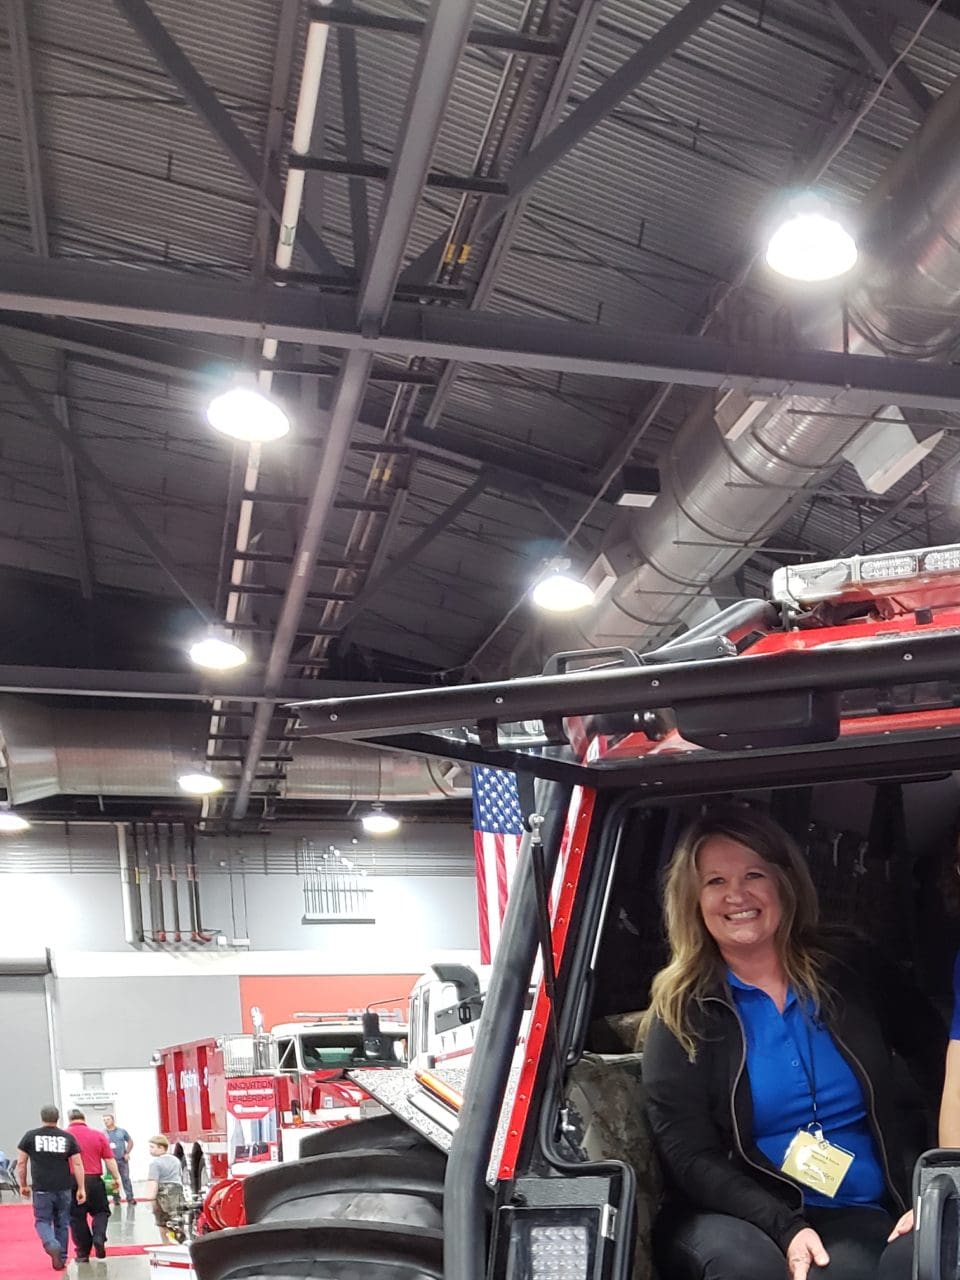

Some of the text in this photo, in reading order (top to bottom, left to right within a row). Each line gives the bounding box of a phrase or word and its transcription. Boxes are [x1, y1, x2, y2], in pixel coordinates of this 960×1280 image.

[228, 1080, 273, 1090] INNOVATION
[228, 1094, 274, 1103] LEADERSHIP
[35, 1142, 66, 1153] FIRE
